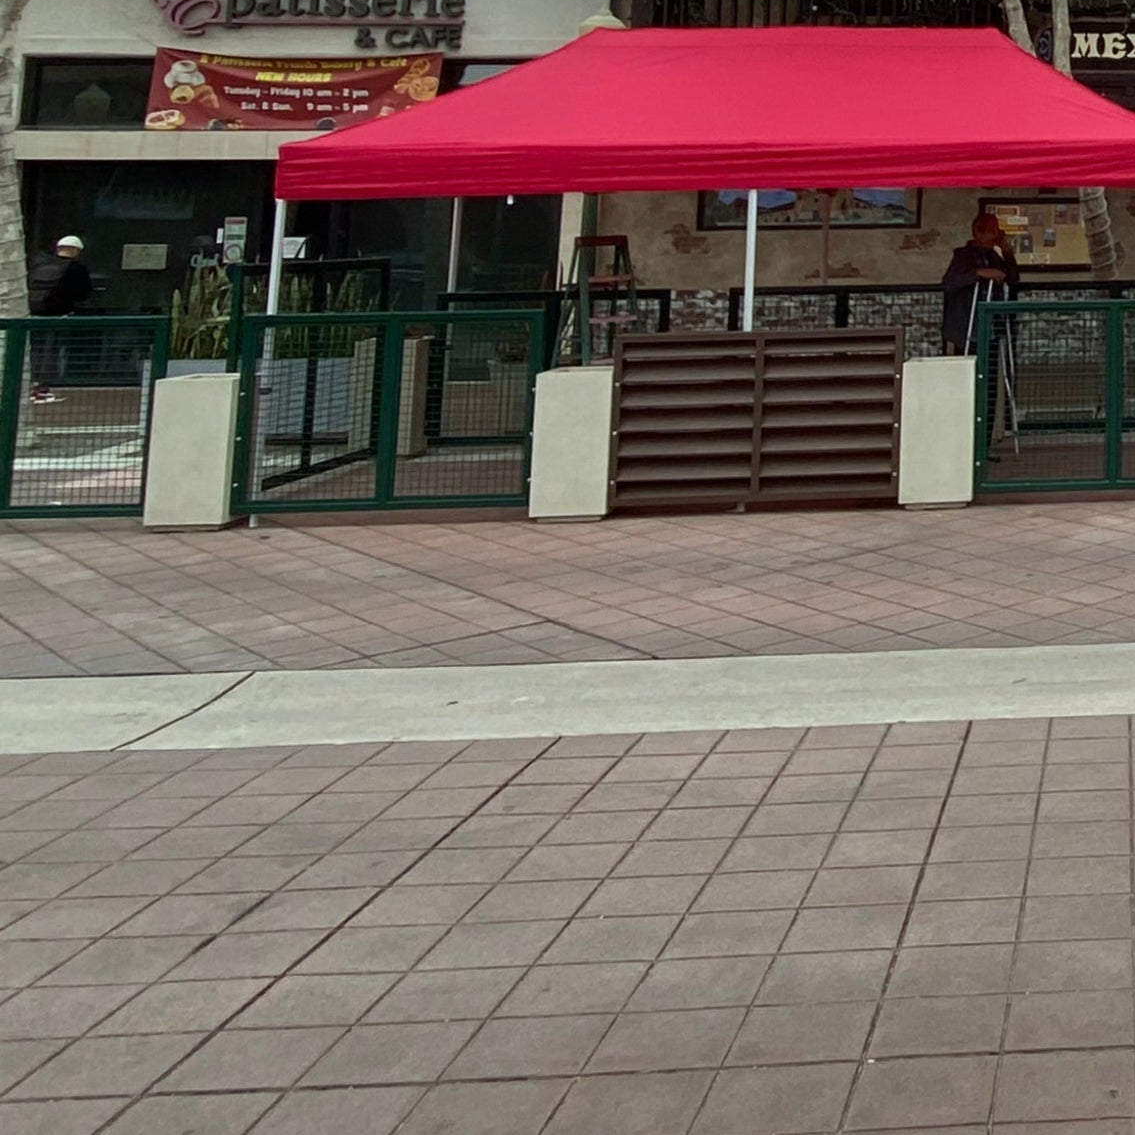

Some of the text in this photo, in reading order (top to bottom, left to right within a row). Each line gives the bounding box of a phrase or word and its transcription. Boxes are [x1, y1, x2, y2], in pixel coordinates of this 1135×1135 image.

[354, 28, 376, 48] &
[255, 72, 332, 82] NEW HOURS
[270, 87, 300, 98] Friday
